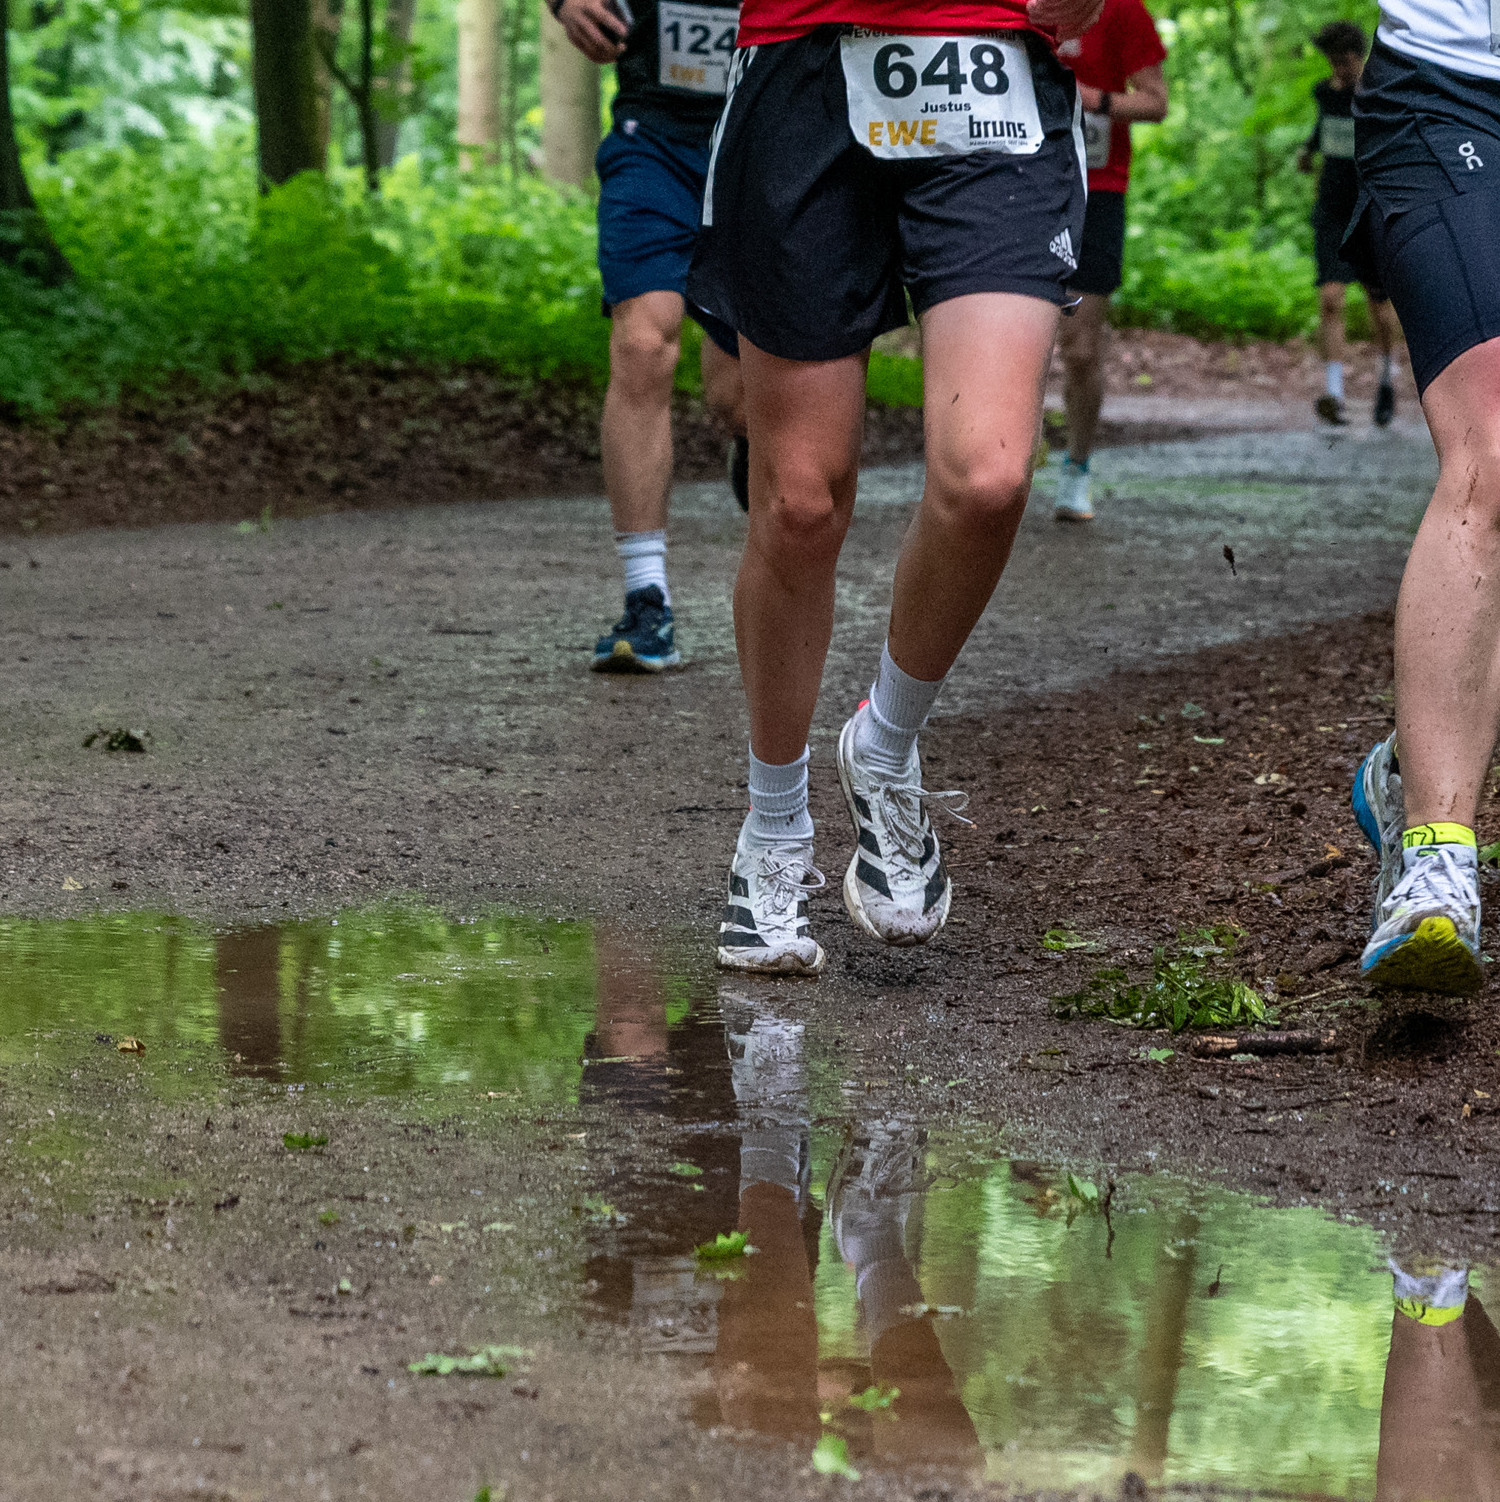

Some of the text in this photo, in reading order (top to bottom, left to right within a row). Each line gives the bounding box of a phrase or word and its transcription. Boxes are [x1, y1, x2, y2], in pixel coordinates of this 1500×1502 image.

[665, 21, 737, 56] 124
[873, 41, 1009, 98] 648
[920, 102, 971, 113] Justus
[868, 119, 938, 146] EWE
[969, 115, 1027, 139] bruns
